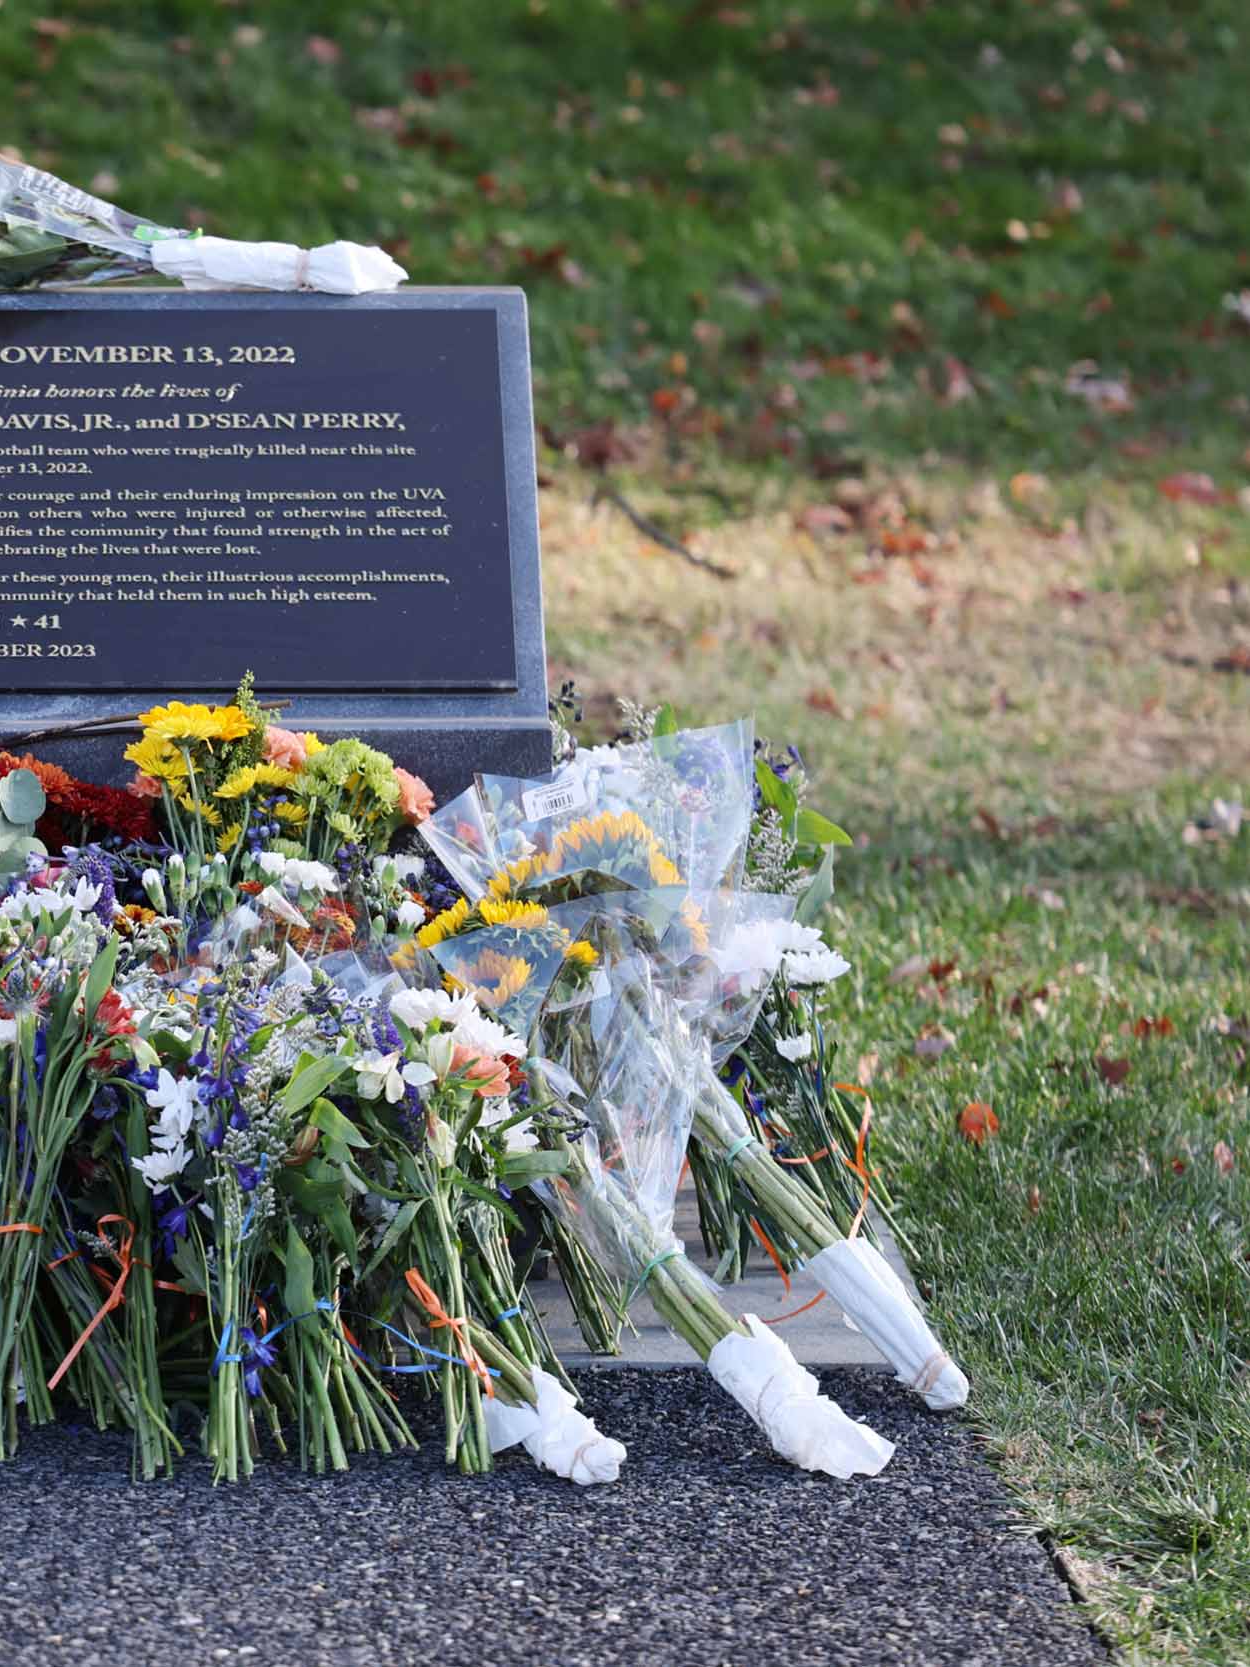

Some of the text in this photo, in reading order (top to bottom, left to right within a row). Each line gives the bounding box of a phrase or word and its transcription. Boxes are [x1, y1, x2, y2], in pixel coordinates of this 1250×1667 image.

[182, 346, 224, 366] 13,
[228, 346, 296, 364] 2022
[44, 384, 117, 398] honors
[121, 383, 156, 398] the
[159, 383, 211, 398] lives
[215, 383, 243, 402] of
[78, 413, 131, 432] JR.,
[135, 413, 181, 429] and
[186, 413, 297, 429] D'SEAN
[302, 412, 406, 431] PERRY,
[48, 447, 89, 456] team
[92, 444, 128, 456] who
[131, 448, 171, 456] were
[174, 444, 254, 459] tragically
[257, 444, 306, 455] killed
[310, 447, 348, 456] near
[350, 444, 383, 455] this
[386, 444, 416, 456] site
[18, 462, 43, 476] 13,
[46, 462, 93, 474] 2022.
[7, 492, 75, 504] courage
[80, 488, 111, 500] and
[117, 489, 159, 500] their
[162, 488, 241, 504] enduring
[246, 489, 338, 503] impression
[342, 492, 364, 500] on
[370, 488, 398, 500] the
[402, 488, 446, 500] UVA
[28, 507, 82, 519] others
[91, 507, 128, 518] who
[136, 510, 177, 518] were
[186, 506, 246, 521] injured
[255, 510, 275, 518] or
[282, 506, 366, 518] otherwise
[376, 506, 448, 519] affected.
[38, 525, 66, 536] the
[70, 523, 168, 540] community
[173, 524, 208, 536] that
[213, 524, 263, 536] found
[268, 524, 340, 539] strength
[346, 525, 363, 536] in
[368, 524, 396, 536] the
[401, 527, 427, 536] act
[432, 524, 452, 536] of
[70, 543, 98, 554] the
[102, 543, 140, 554] lives
[143, 543, 179, 554] that
[182, 546, 222, 554] were
[225, 542, 261, 555] lost.
[12, 571, 56, 582] these
[59, 574, 113, 586] young
[116, 574, 158, 584] men,
[162, 570, 204, 582] their
[207, 570, 294, 588] illustrious
[297, 570, 450, 585] accomplishments,
[78, 589, 114, 600] that
[117, 588, 154, 600] held
[158, 588, 203, 600] them
[207, 589, 224, 600] in
[228, 588, 267, 600] such
[271, 588, 310, 604] high
[313, 591, 377, 601] esteem.
[33, 614, 62, 629] 41
[47, 644, 96, 657] 2023
